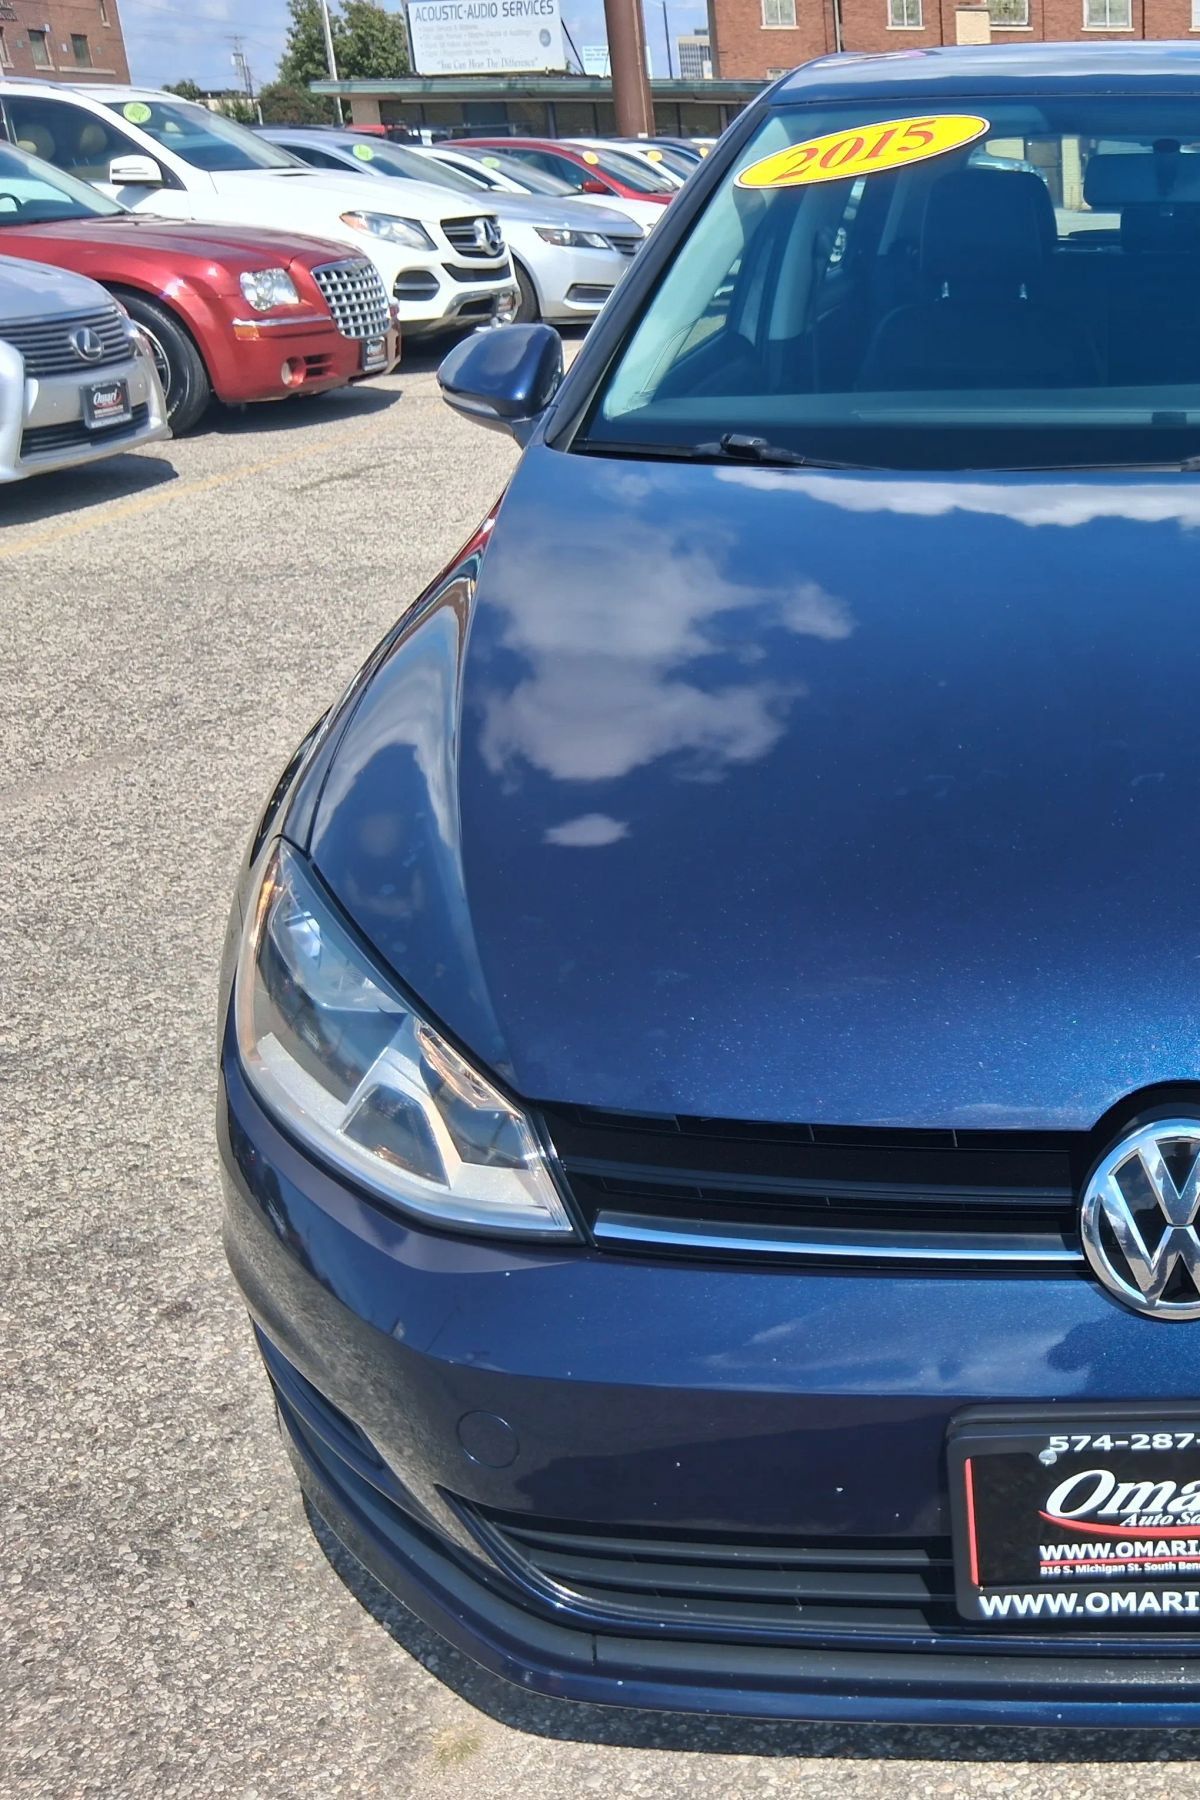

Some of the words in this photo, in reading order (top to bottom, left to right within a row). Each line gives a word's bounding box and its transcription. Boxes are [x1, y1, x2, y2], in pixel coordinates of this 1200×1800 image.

[502, 0, 554, 17] SERVICES
[767, 119, 937, 184] 2015
[1119, 1511, 1174, 1527] Auto
[1040, 1565, 1062, 1575] 816
[1062, 1565, 1074, 1574] S.
[1075, 1563, 1126, 1575] Michigan
[1127, 1562, 1142, 1572] St.
[1144, 1561, 1177, 1571] South
